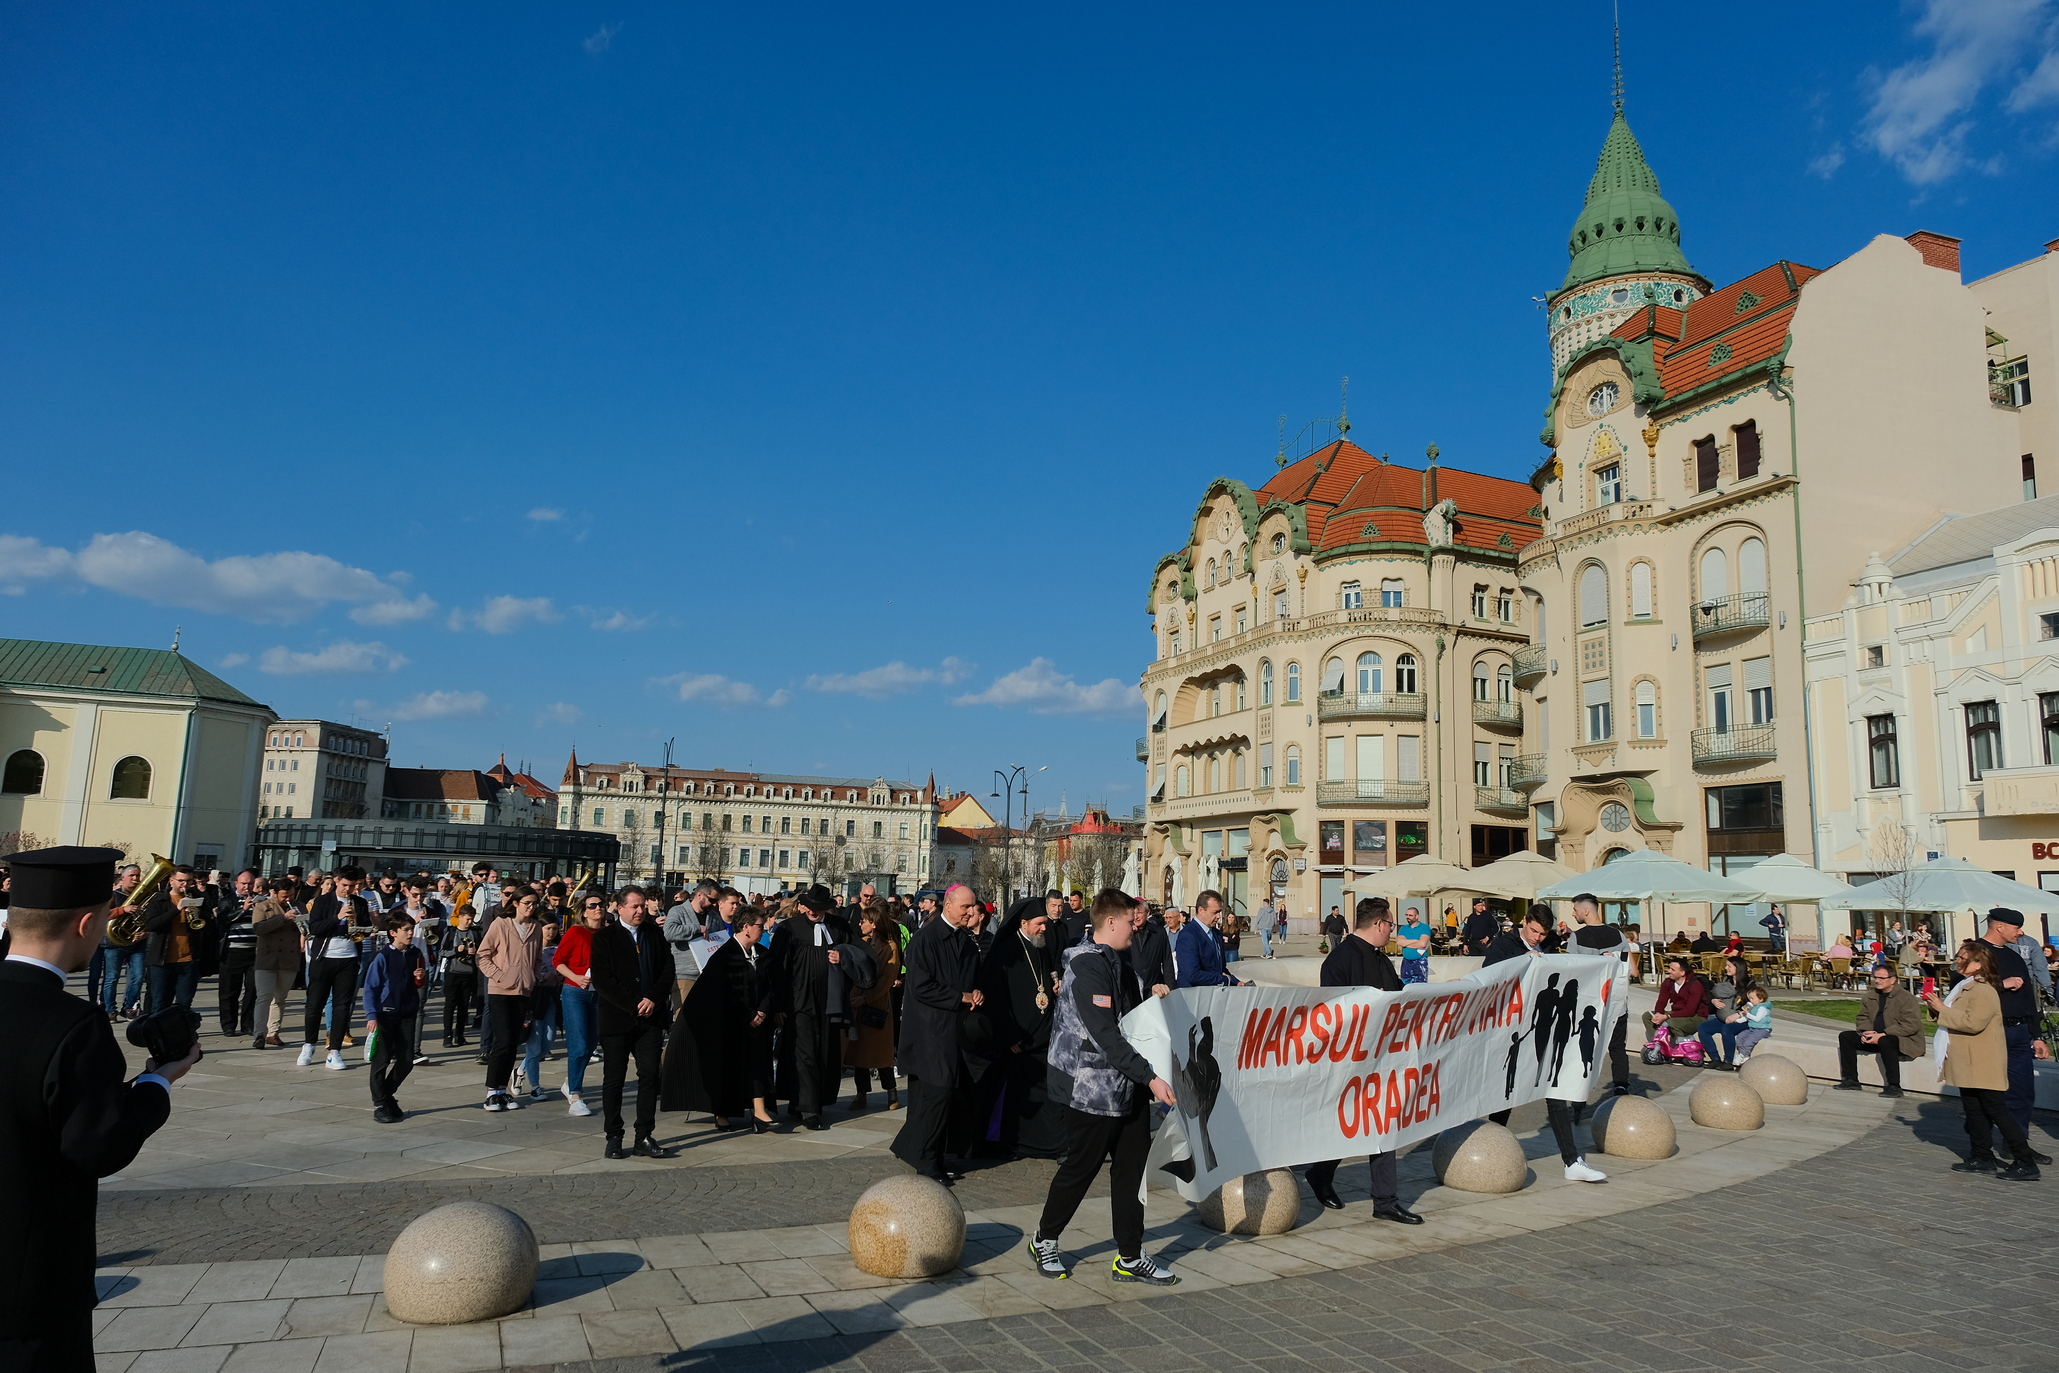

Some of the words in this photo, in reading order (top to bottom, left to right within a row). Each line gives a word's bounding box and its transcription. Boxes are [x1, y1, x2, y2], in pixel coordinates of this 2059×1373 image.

[1237, 1002, 1370, 1070] MARSUL
[1373, 989, 1479, 1059] PENTRU
[1337, 1058, 1441, 1139] ORADEA
